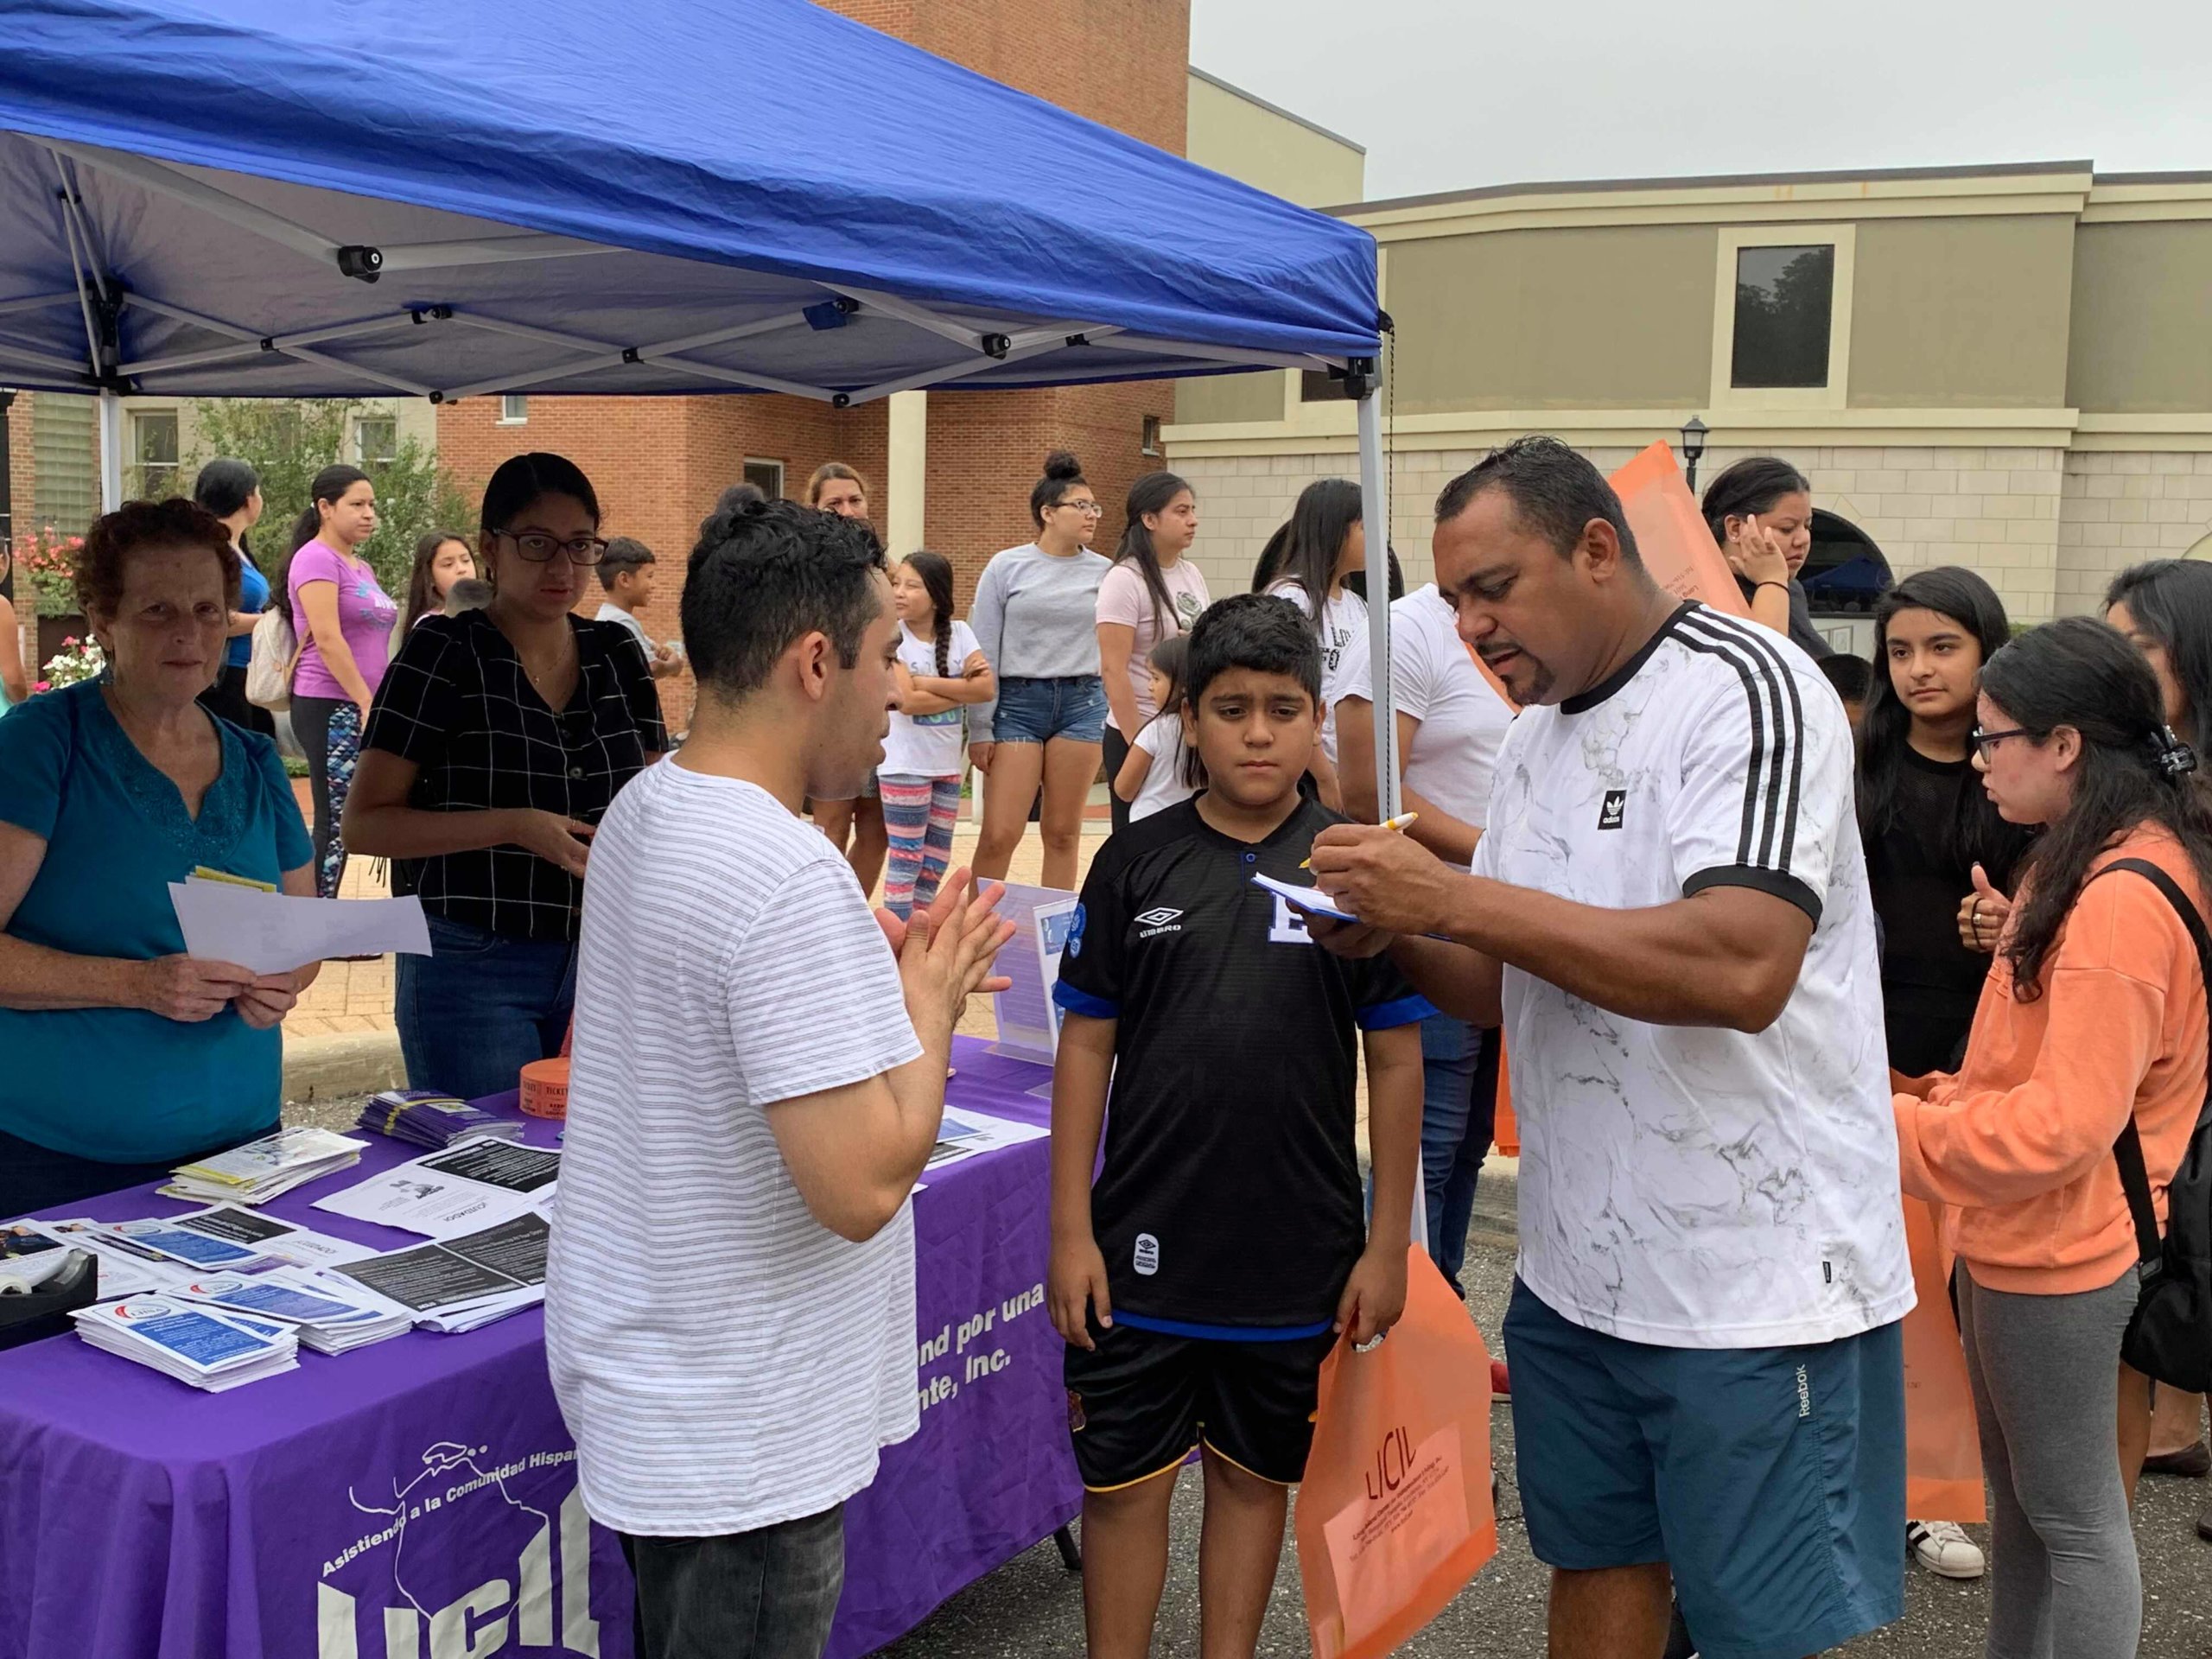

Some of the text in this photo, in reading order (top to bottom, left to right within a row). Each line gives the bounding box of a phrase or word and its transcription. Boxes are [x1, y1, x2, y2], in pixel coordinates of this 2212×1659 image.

[919, 1283, 1045, 1367] nd por una
[918, 1349, 1011, 1411] nte, Inc.
[1796, 1363, 1811, 1418] Reebok
[1365, 1426, 1417, 1500] LICIL
[321, 1514, 408, 1578] Asistiendo
[410, 1505, 421, 1520] a
[424, 1496, 442, 1513] la
[445, 1458, 526, 1503] Comunidad
